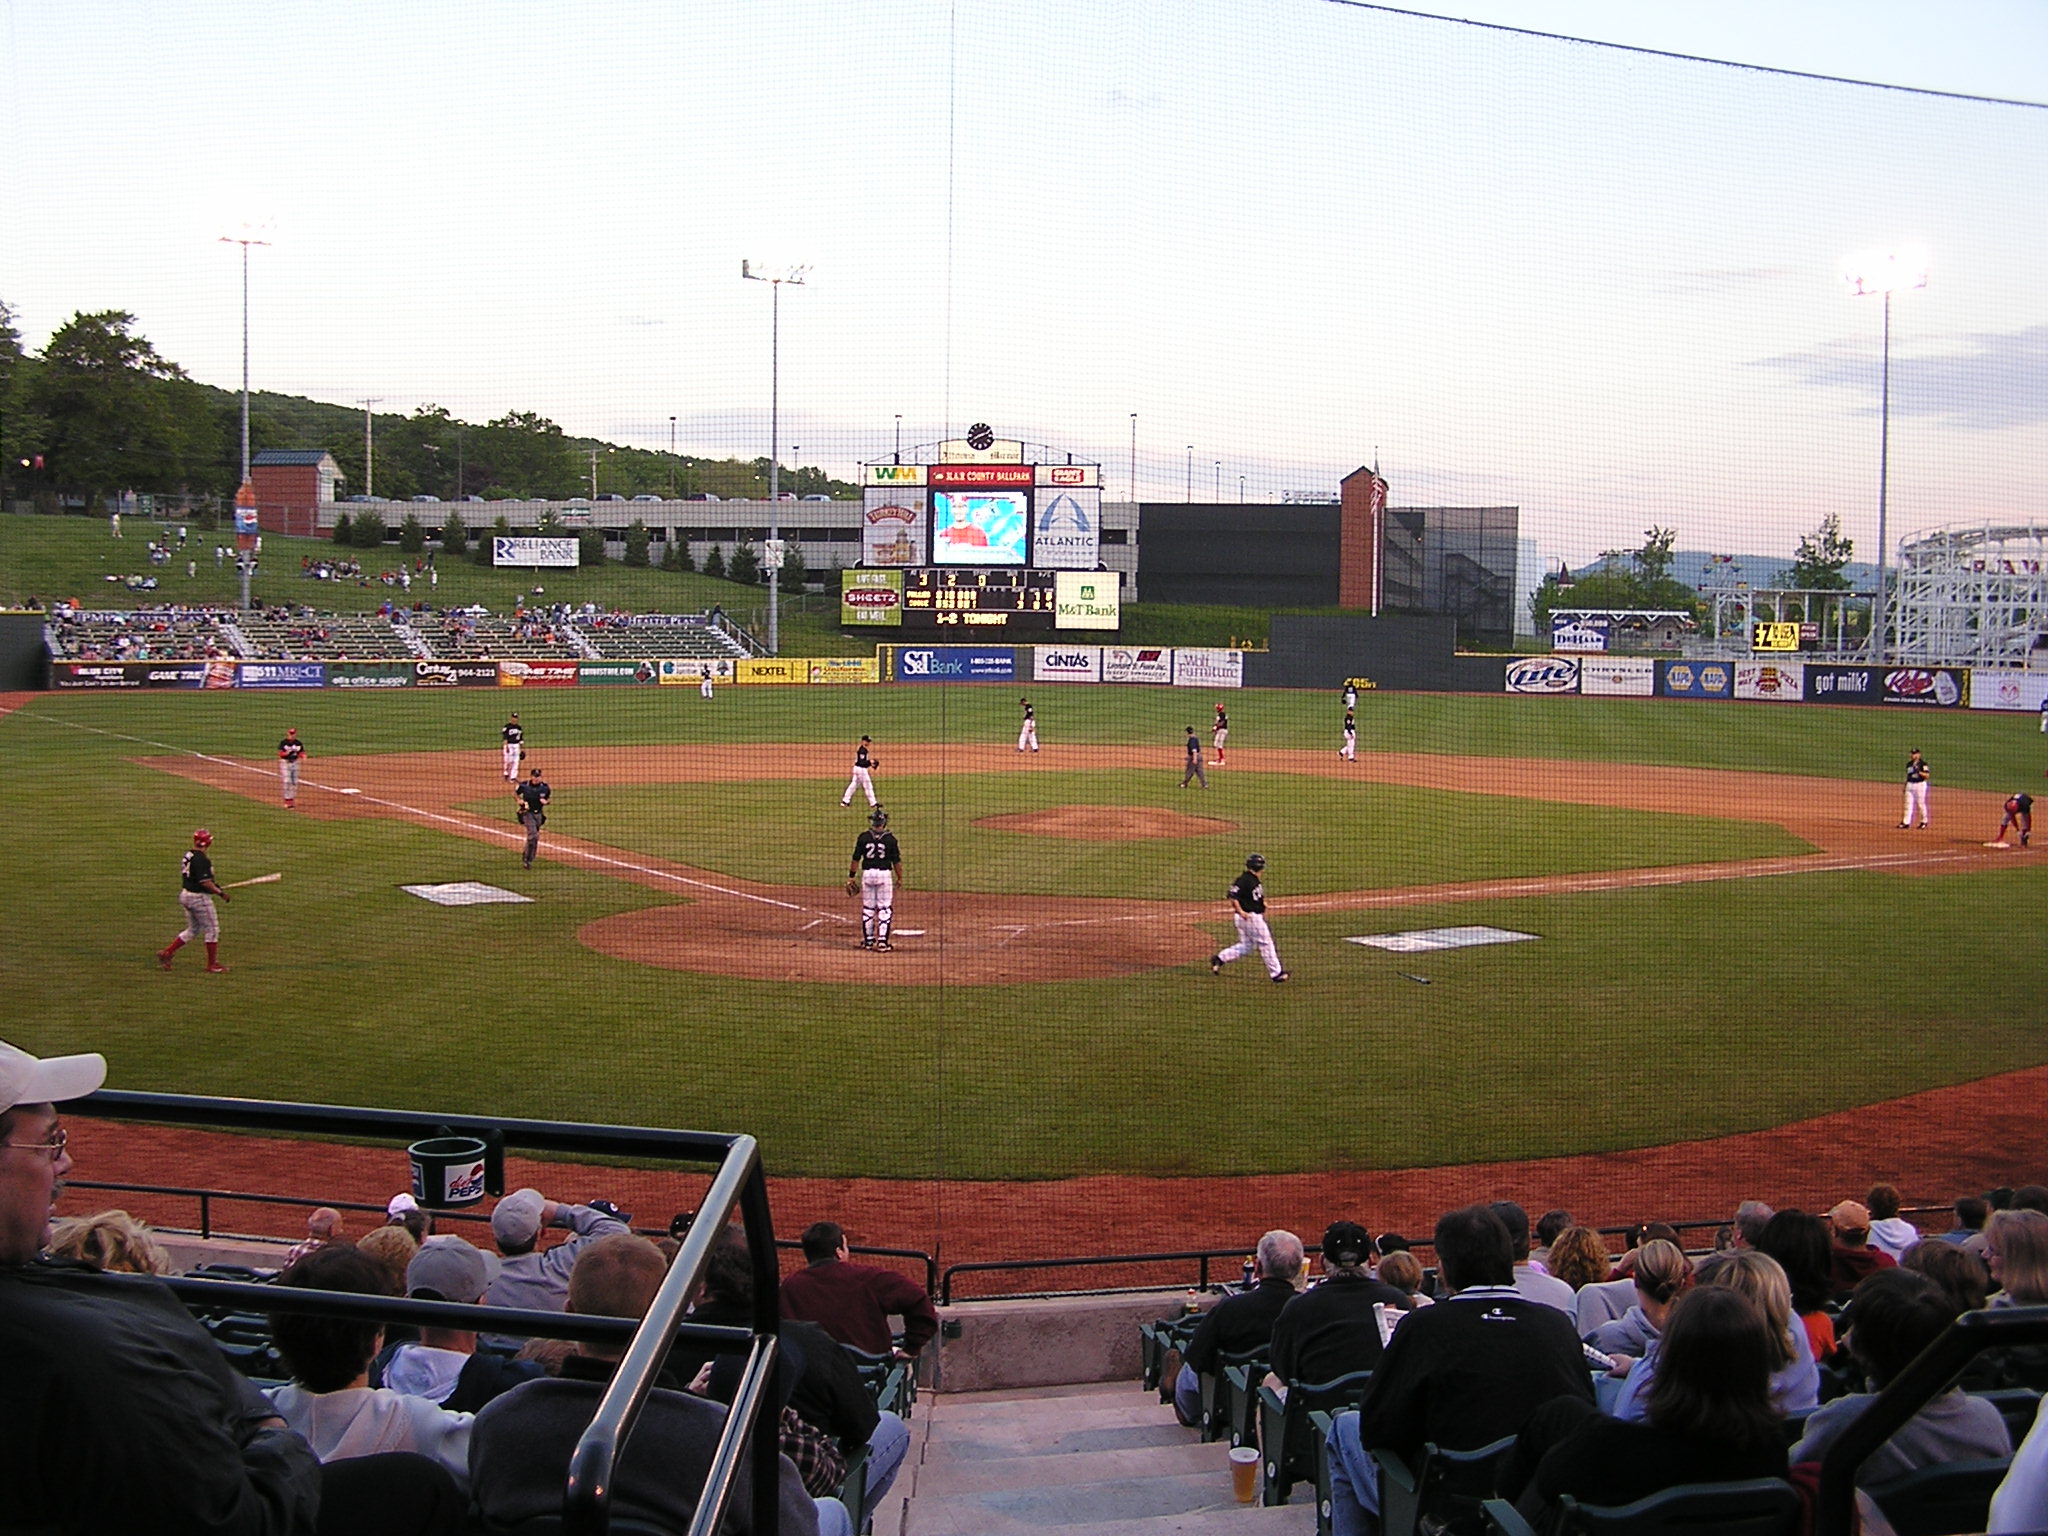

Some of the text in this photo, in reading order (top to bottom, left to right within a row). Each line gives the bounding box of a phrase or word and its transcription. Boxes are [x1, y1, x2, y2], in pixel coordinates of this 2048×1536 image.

[876, 467, 917, 480] WM
[967, 471, 994, 481] COUNTY
[997, 471, 1030, 481] BALLPARK
[514, 539, 572, 550] RELIANCE
[1036, 537, 1093, 547] ATLANTIC
[540, 550, 573, 560] BANK
[919, 574, 928, 586] 3
[947, 574, 956, 586] 2
[978, 574, 987, 587] 0
[1012, 575, 1017, 587] 1
[848, 593, 896, 602] SHEETZ
[1058, 604, 1117, 617] M&T Bank
[962, 613, 1008, 625] TONIGHT
[904, 650, 963, 675] S&T Bank
[1184, 654, 1210, 667] Wolf
[751, 667, 787, 677] NEXTEL
[1178, 663, 1239, 679] Furniture
[1512, 666, 1574, 686] Lite
[351, 675, 377, 685] office
[379, 676, 408, 686] supply
[1671, 672, 1690, 684] NAPA
[1704, 673, 1723, 685] NAPA
[1815, 672, 1835, 695] got
[1837, 672, 1869, 692] milk?
[865, 843, 886, 859] 23
[449, 1175, 473, 1188] diet
[448, 1186, 483, 1199] PEPS
